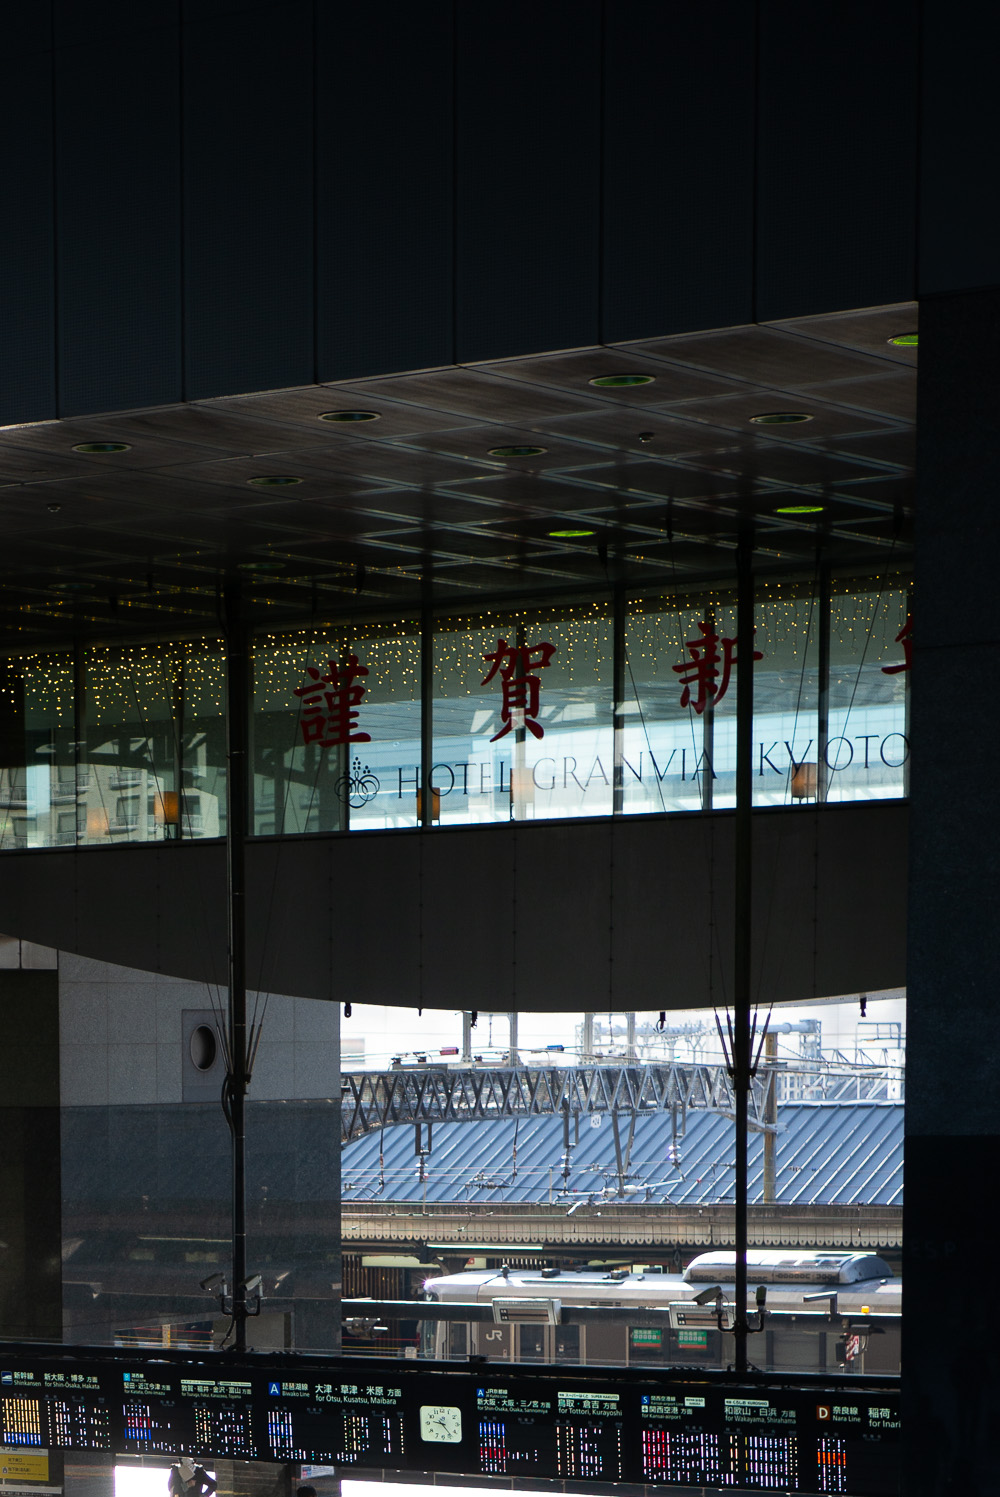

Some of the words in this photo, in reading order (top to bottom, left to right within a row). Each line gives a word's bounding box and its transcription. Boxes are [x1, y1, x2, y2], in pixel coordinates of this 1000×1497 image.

[294, 617, 912, 747] 謹賀新
[398, 760, 513, 799] HOTEL
[533, 748, 717, 792] GRANVIA
[759, 733, 910, 777] KYOTO
[486, 1330, 502, 1340] JR
[14, 1372, 34, 1380] 新幹線
[44, 1373, 84, 1382] 新大阪・博多
[271, 1384, 278, 1393] A
[282, 1383, 308, 1391] 琵琶湖線
[315, 1384, 383, 1395] 大津・草津・米原
[387, 1389, 401, 1397] 方面
[478, 1389, 484, 1397] A
[344, 1396, 369, 1404] Kusatsu,
[371, 1397, 396, 1405] Maibara
[477, 1399, 539, 1408] 新大阪・大阪・三ノ宮
[558, 1399, 599, 1409] 鳥取・倉吉
[643, 1396, 647, 1404] S
[592, 1409, 622, 1417] Kurayoshi
[649, 1406, 678, 1414] 関西空港
[724, 1406, 777, 1417] 和歌山・白浜
[781, 1410, 796, 1418] 方面
[819, 1408, 828, 1419] D
[833, 1406, 858, 1415] 奈良線
[734, 1416, 765, 1424] Wakayama,
[869, 1419, 880, 1427] for
